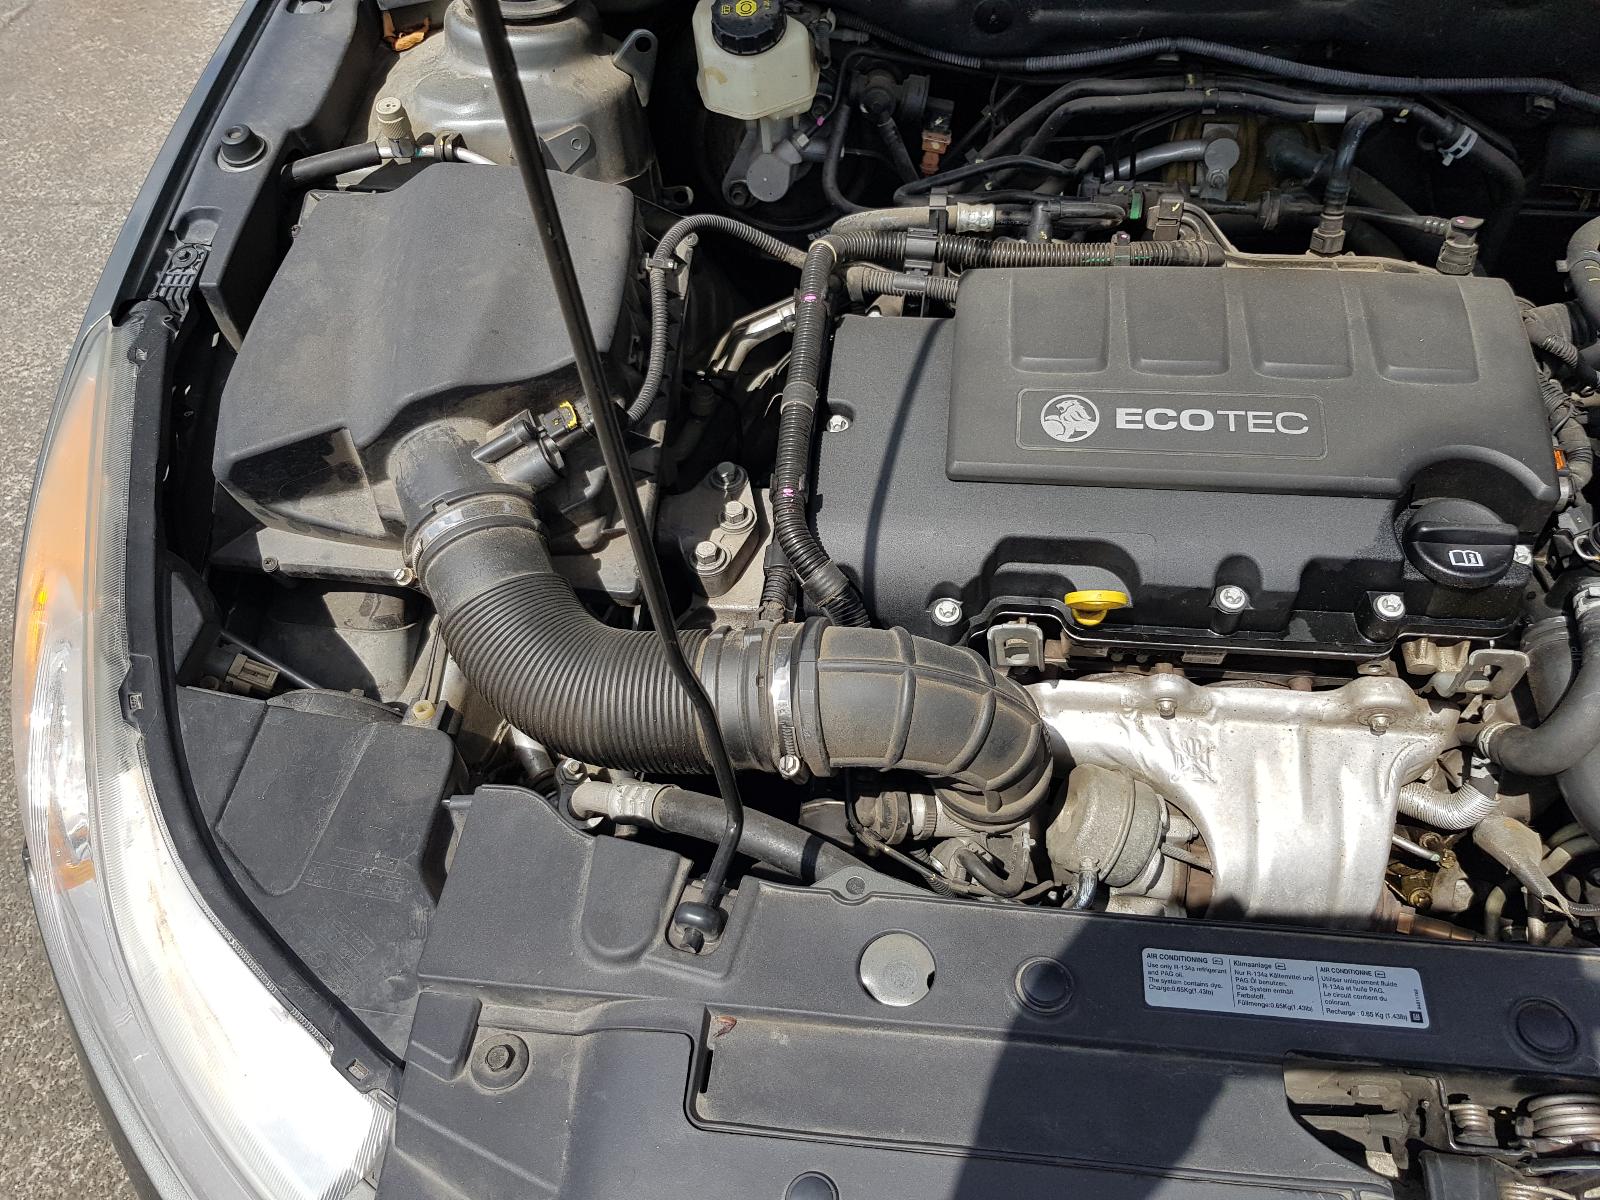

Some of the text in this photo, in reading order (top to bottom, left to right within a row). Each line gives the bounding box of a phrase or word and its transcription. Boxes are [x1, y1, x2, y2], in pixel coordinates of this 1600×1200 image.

[1116, 408, 1309, 435] ECOTEC
[1160, 954, 1208, 963] CONDITIONING
[1234, 961, 1272, 970] Klimaanlage
[1197, 966, 1227, 974] refrigerant
[1344, 978, 1379, 986] uniquement
[1326, 1008, 1355, 1016] Recharge
